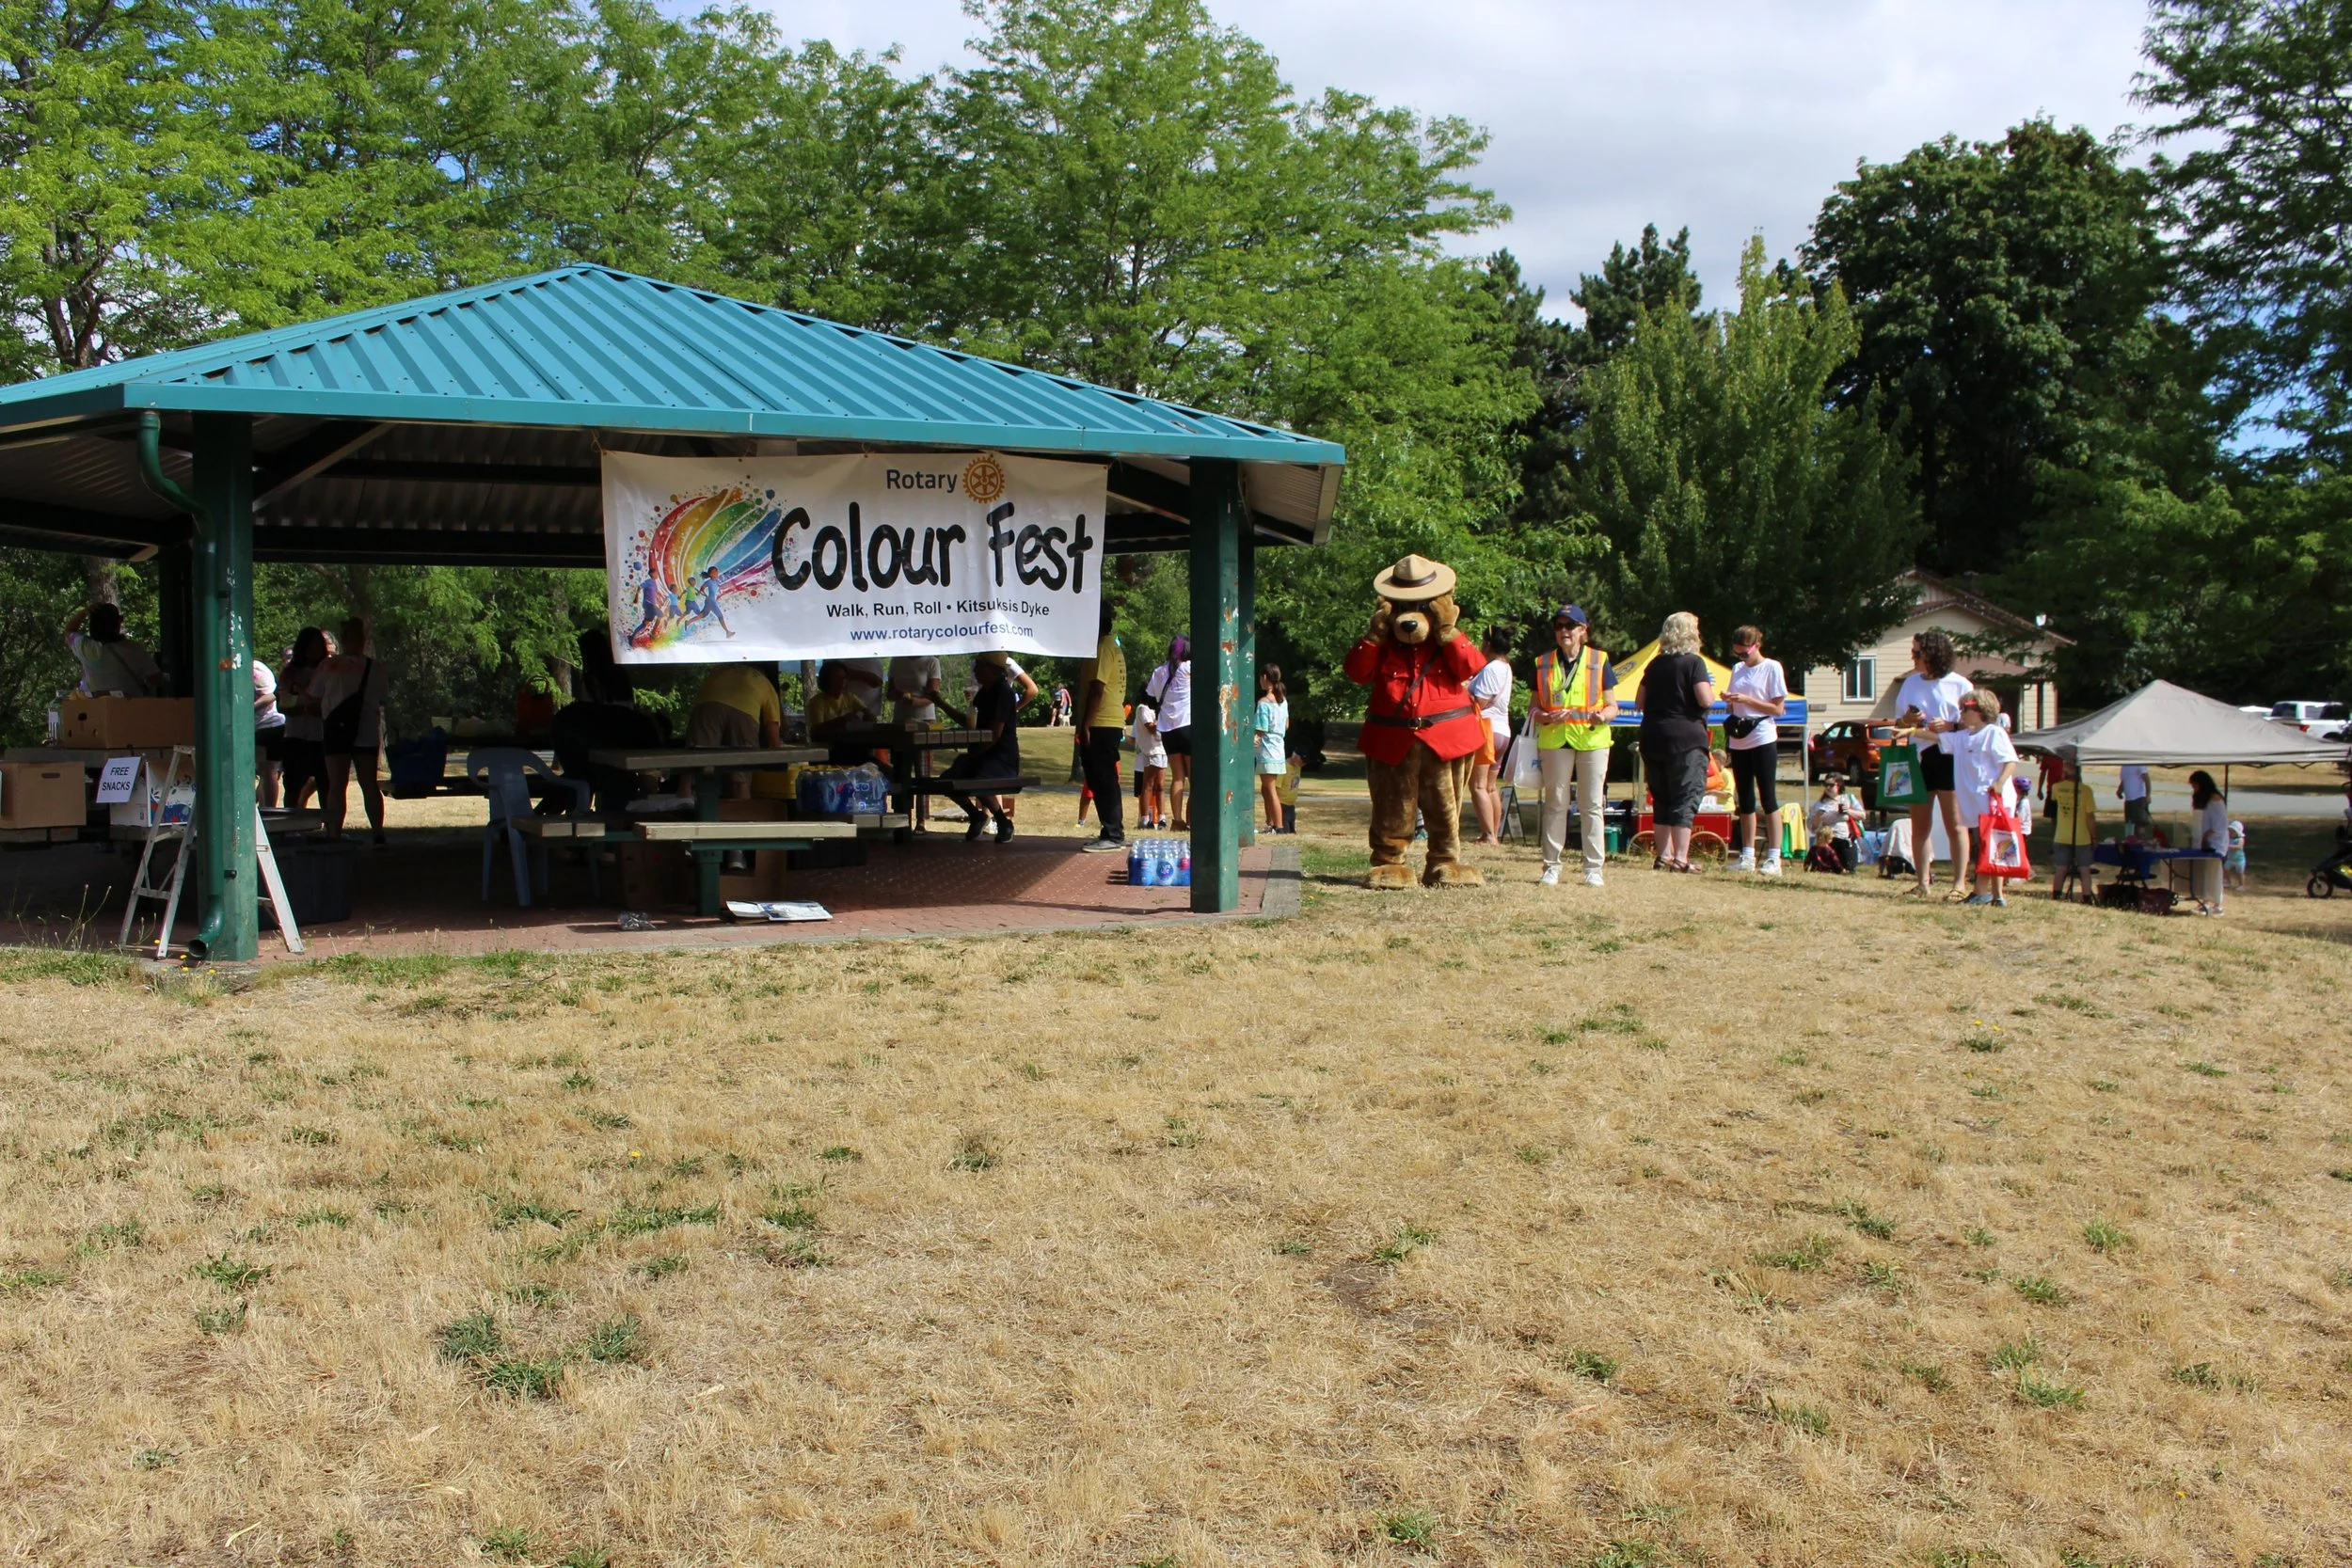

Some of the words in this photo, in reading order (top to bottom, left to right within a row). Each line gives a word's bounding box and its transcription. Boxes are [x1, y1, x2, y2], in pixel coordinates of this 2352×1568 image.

[886, 468, 958, 494] Rotary
[771, 500, 966, 593] Colour
[986, 500, 1094, 594] Fest
[826, 603, 868, 618] Walk,
[873, 602, 909, 617] Run,
[914, 601, 941, 615] Roll
[956, 597, 1019, 613] Kitsuksis
[1021, 600, 1050, 617] Dyke
[850, 620, 1034, 641] www.rotarycolourfest.com
[110, 767, 130, 775] FREE
[102, 781, 131, 791] SNACKS
